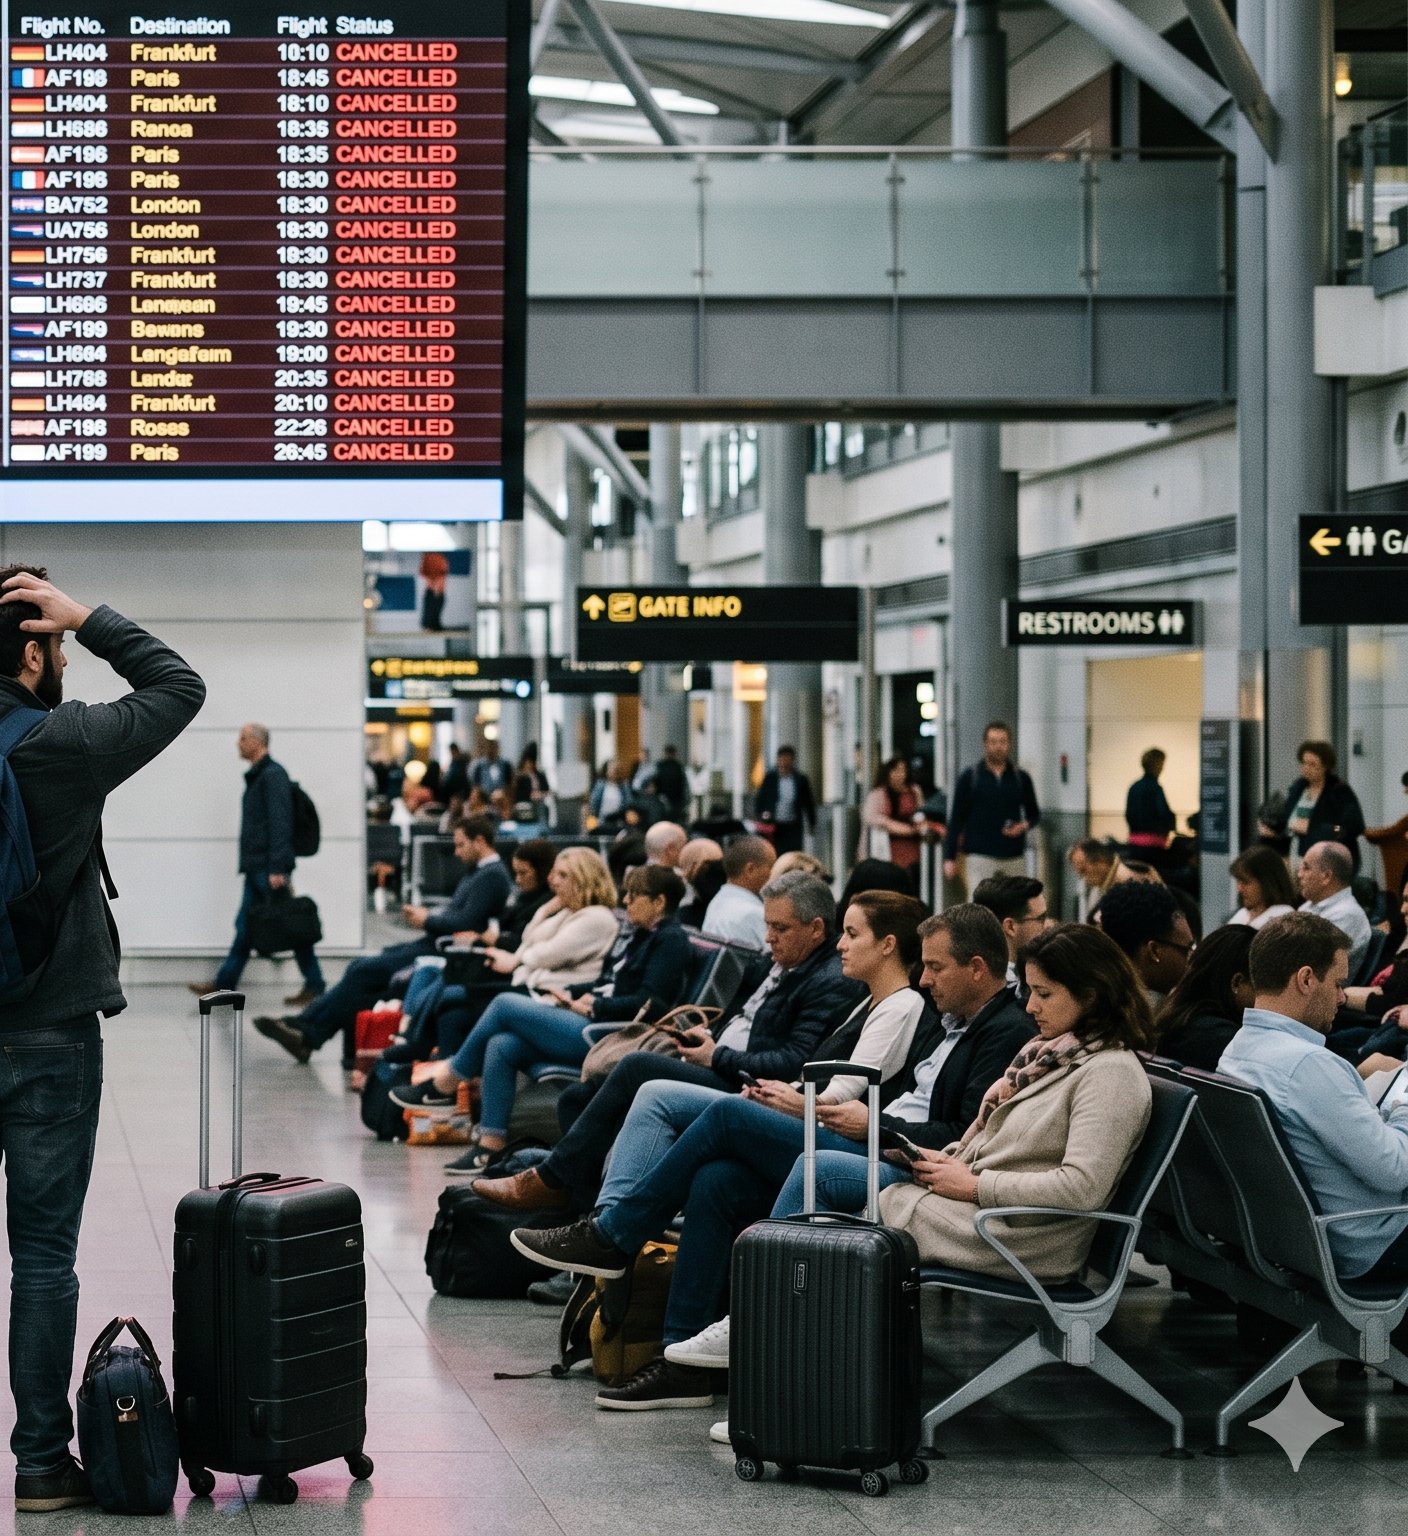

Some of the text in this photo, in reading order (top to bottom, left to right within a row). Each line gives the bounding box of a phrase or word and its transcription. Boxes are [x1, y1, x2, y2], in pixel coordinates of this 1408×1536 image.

[21, 16, 393, 38] Flight No. Destination Flight Status
[131, 44, 216, 61] Frankfurt
[336, 44, 457, 61] CANCELLED
[131, 69, 180, 86] Paris
[278, 69, 329, 86] 18:45
[336, 69, 457, 86] CANCELLED
[131, 95, 216, 112] Frankfurt
[336, 95, 456, 112] CANCELLED
[336, 120, 456, 137] CANCELLED
[131, 146, 179, 163] Paris
[277, 146, 328, 163] 18:35
[336, 146, 456, 162] CANCELLED
[131, 171, 179, 188] Paris
[277, 171, 328, 188] 18:30
[336, 171, 456, 188] CANCELLED
[131, 197, 200, 213] London
[277, 196, 328, 213] 18:30
[336, 196, 456, 213] CANCELLED
[131, 222, 199, 238] London
[277, 221, 328, 238] 18:30
[336, 221, 456, 238] CANCELLED
[131, 247, 215, 263] Frankfurt
[336, 246, 455, 263] CANCELLED
[132, 271, 216, 288] Frankfurt
[336, 271, 455, 288] CANCELLED
[277, 296, 328, 313] 19:45
[336, 296, 455, 312] CANCELLED
[277, 321, 327, 337] 19:30
[335, 321, 455, 337] CANCELLED
[277, 345, 327, 362] 19:00
[335, 345, 454, 362] CANCELLED
[275, 370, 327, 387] 20:35
[335, 370, 454, 386] CANCELLED
[131, 394, 215, 411] Frankfurt
[275, 394, 327, 411] 20:10
[334, 394, 454, 411] CANCELLED
[275, 419, 327, 436] 22:26
[334, 419, 454, 435] CANCELLED
[131, 444, 179, 460] Paris
[274, 443, 327, 460] 26:45
[334, 443, 454, 460] CANCELLED
[639, 596, 741, 617] GATE INFO
[1019, 612, 1155, 634] RESTROOMS
